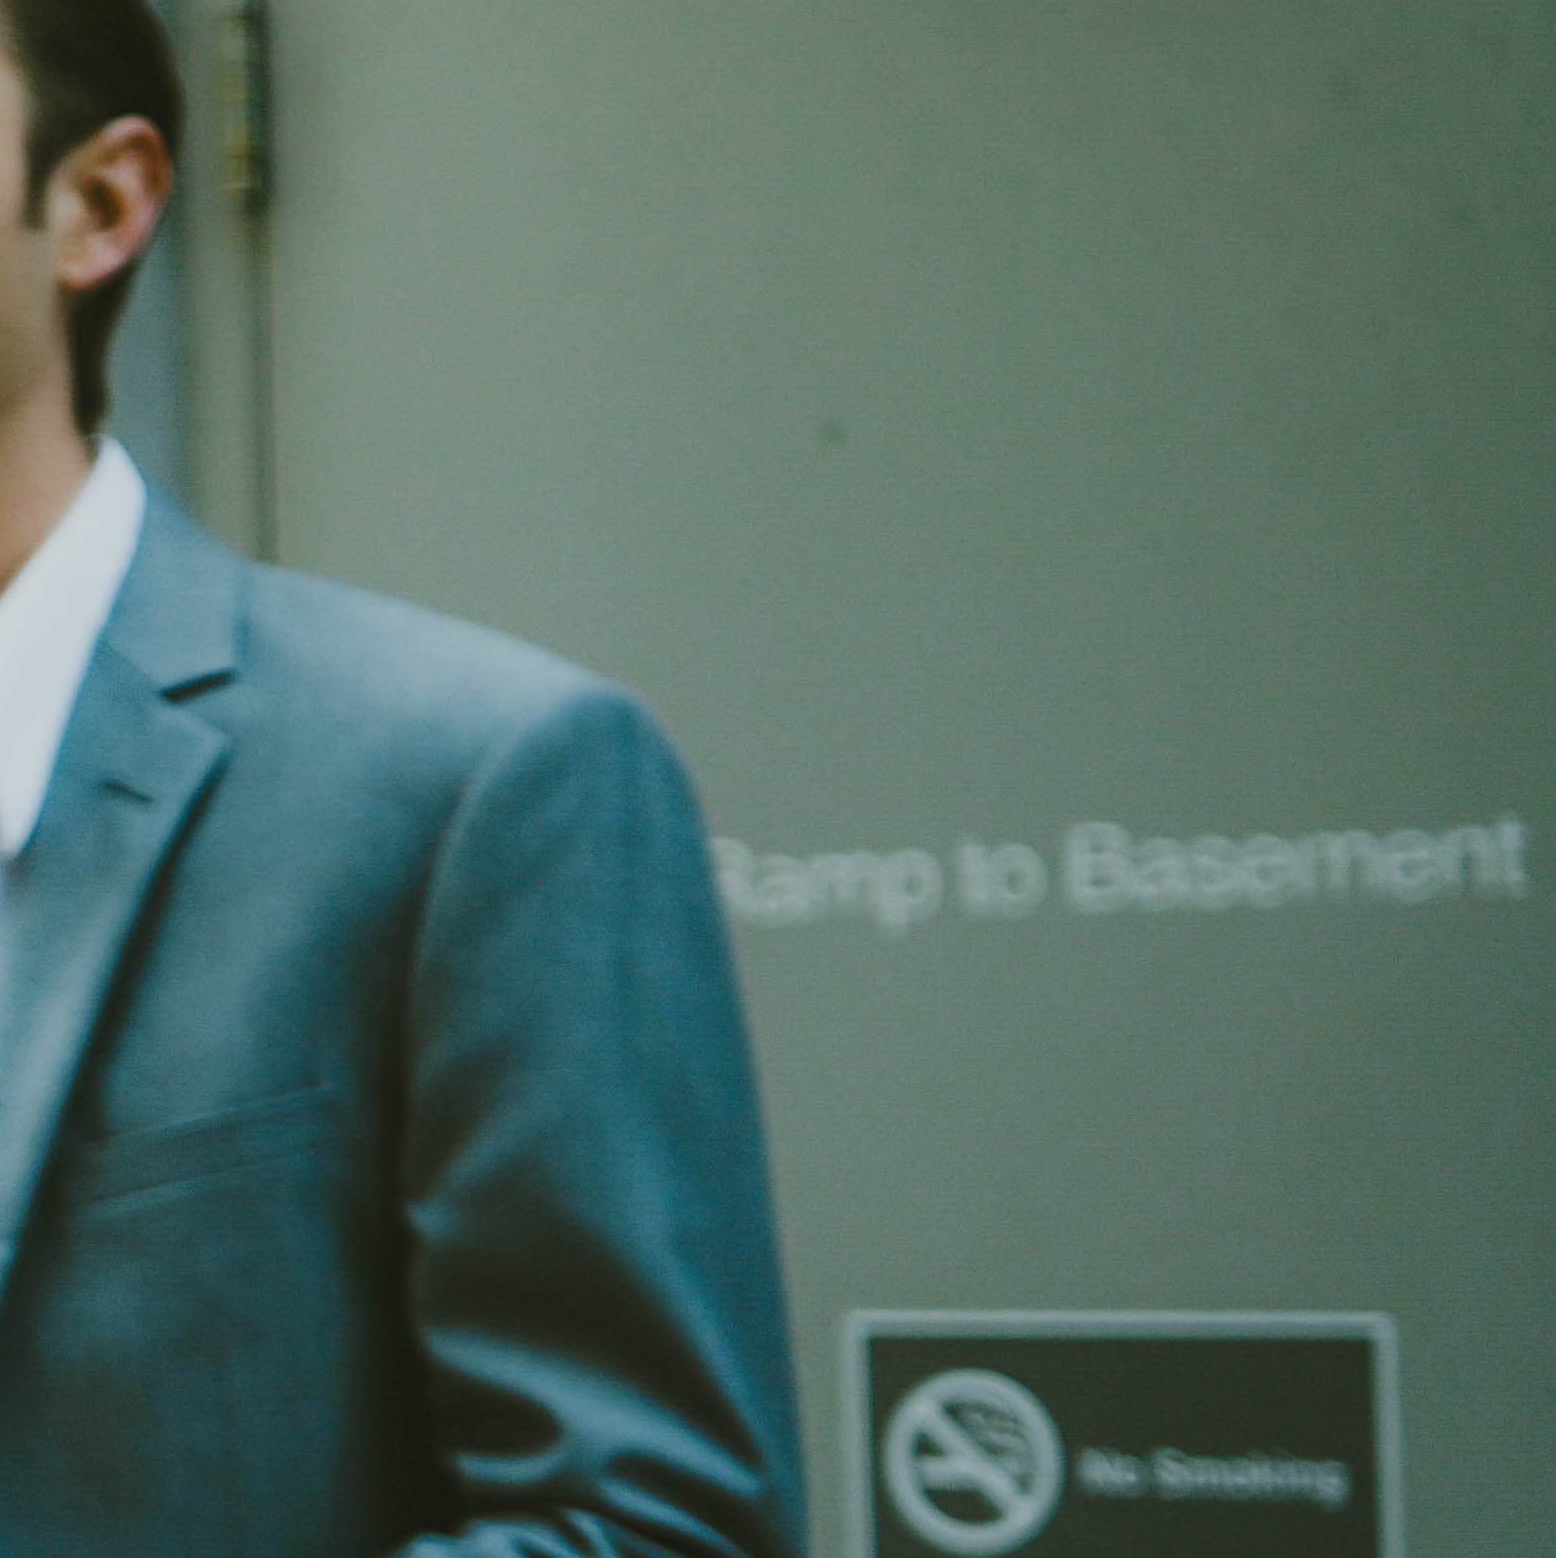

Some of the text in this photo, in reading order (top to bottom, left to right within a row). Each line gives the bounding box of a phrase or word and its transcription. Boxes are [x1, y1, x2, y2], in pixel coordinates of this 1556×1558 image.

[959, 843, 1049, 920] to
[1063, 816, 1526, 913] Basement
[1074, 1446, 1351, 1512] No Smoking
